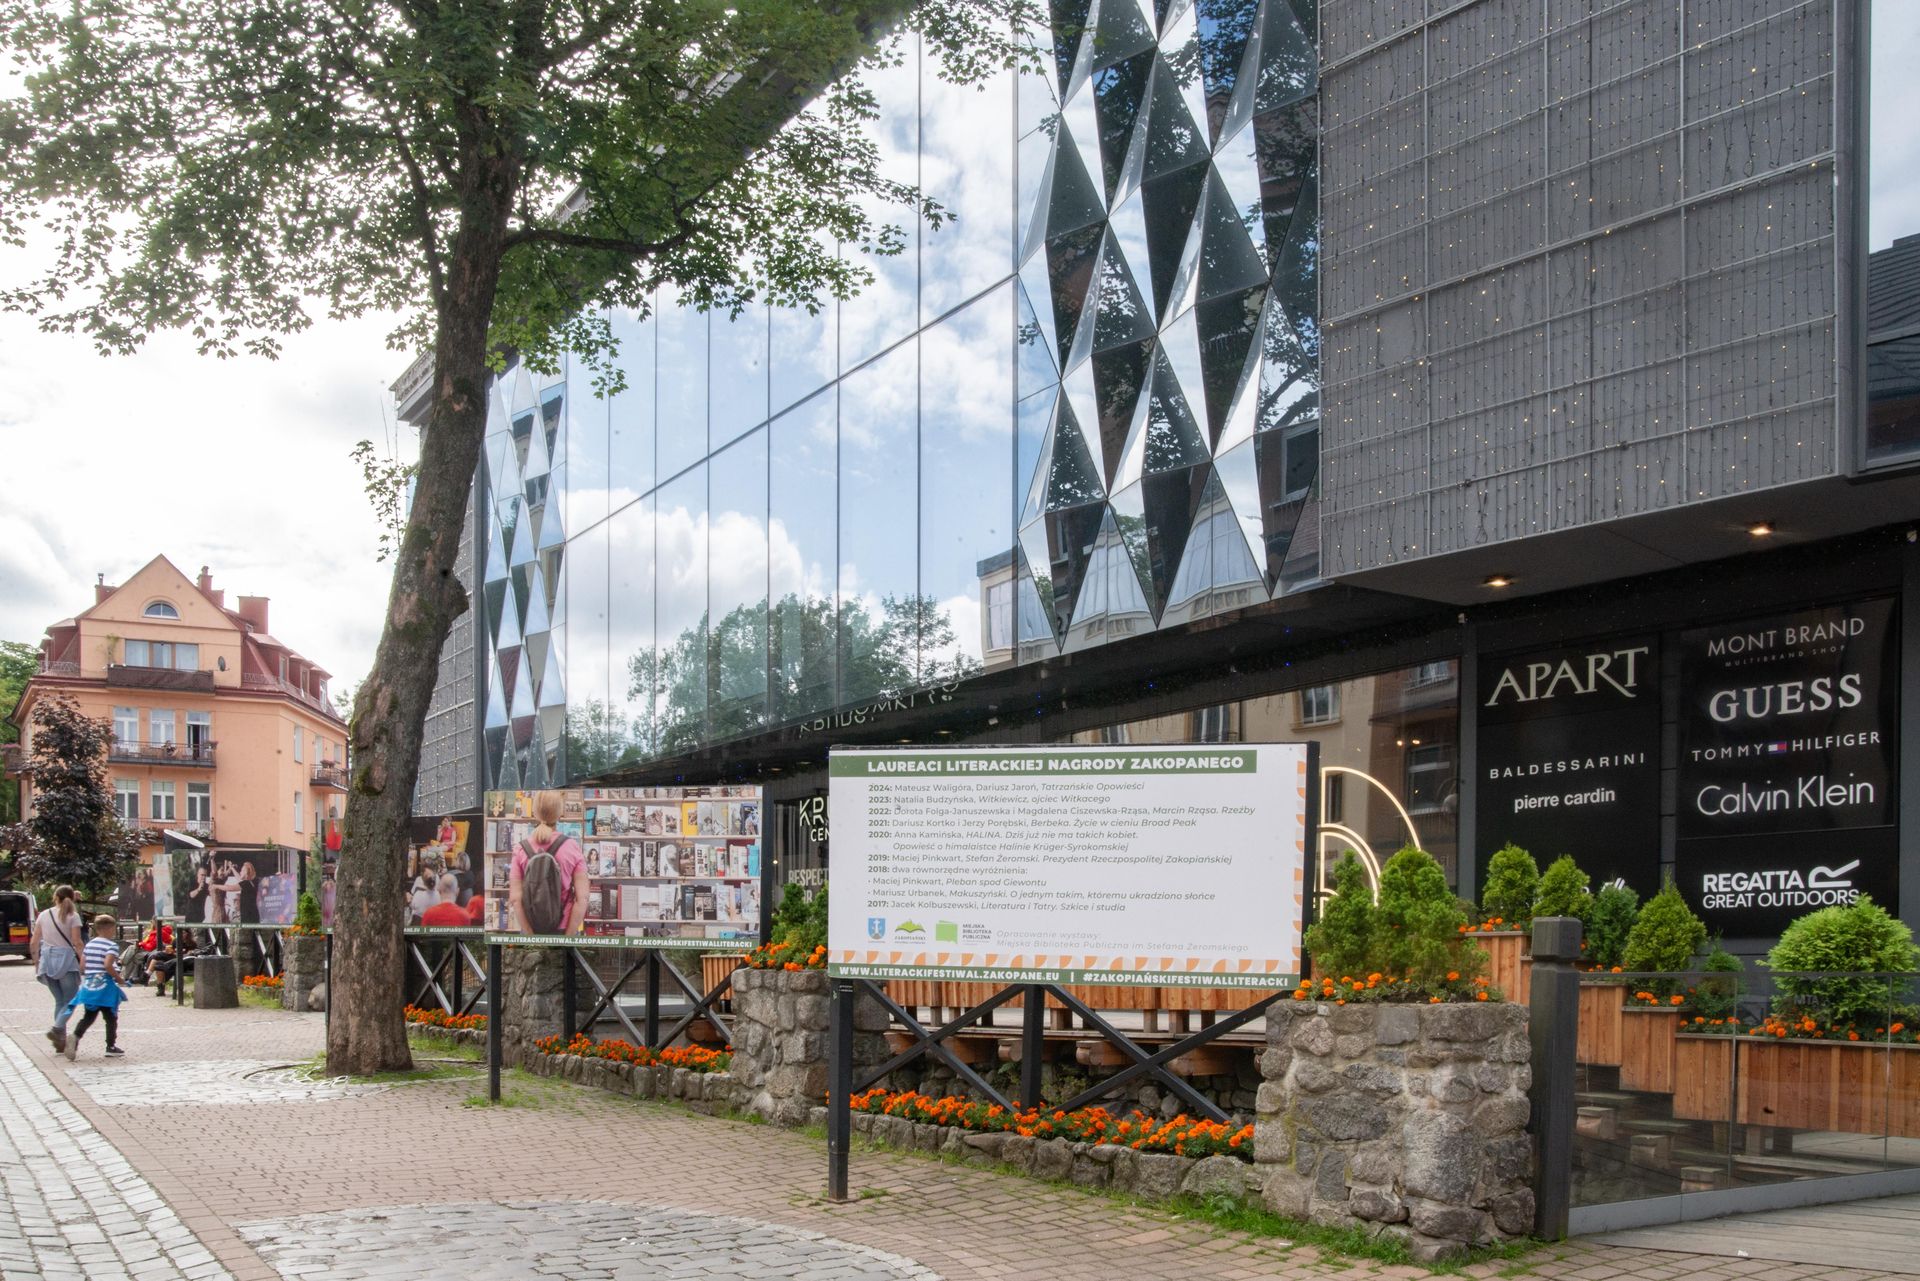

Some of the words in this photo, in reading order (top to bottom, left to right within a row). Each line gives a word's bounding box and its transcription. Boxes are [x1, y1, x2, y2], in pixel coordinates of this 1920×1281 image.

[1707, 631, 1777, 657] MONT
[1785, 618, 1865, 645] BRAND
[1724, 651, 1804, 667] MULTIBRAND
[1812, 645, 1846, 656] SHOP
[1484, 646, 1649, 707] APART
[1709, 673, 1862, 722] GUESS
[1692, 743, 1763, 762] TOMMY
[1792, 731, 1881, 751] HILFIGER
[868, 761, 941, 772] LAUREACI
[946, 760, 1043, 772] LITERACKIEJ
[1048, 758, 1126, 770] NAGRODY
[1130, 756, 1244, 769] ZAKOPANEGO
[1489, 752, 1645, 779] BALDESSARINI
[869, 783, 892, 792] 2024:
[895, 783, 930, 792] Mateusz
[933, 783, 973, 794] Waligóra,
[976, 783, 1009, 792] Dariusz
[1011, 783, 1038, 793] Jaroń,
[1041, 782, 1094, 791] Tatrzańskie
[1097, 782, 1144, 793] Opowieści
[1697, 780, 1790, 816] Calvin
[1798, 773, 1874, 809] Klein
[869, 795, 891, 804] 2023:
[894, 795, 923, 804] Natalia
[1032, 795, 1057, 805] ojciec
[1061, 794, 1110, 805] Witkacego
[1513, 794, 1560, 813] pierre
[1564, 787, 1616, 806] cardin
[799, 796, 830, 827] KR
[869, 807, 891, 815] 2022:
[926, 807, 1010, 817] Folga-Januszewska
[1018, 807, 1067, 817] Magdalena
[1153, 806, 1185, 815] Marcin
[869, 819, 890, 827] 2021:
[893, 819, 924, 827] Dariusz
[927, 819, 955, 827] Kortko
[962, 819, 985, 829] Jerzy
[1031, 819, 1071, 827] Berbeka.
[1074, 817, 1097, 829] Życie
[1111, 818, 1139, 827] cieniu
[1141, 818, 1170, 827] Broad
[1173, 818, 1196, 827] Peak
[869, 830, 892, 839] 2020:
[895, 830, 917, 839] Anna
[1005, 831, 1024, 839] Dziś
[1025, 831, 1040, 841] już
[1042, 831, 1057, 839] nie
[1076, 830, 1104, 839] takich
[1107, 830, 1139, 839] kobiet.
[946, 843, 997, 851] himalaistce
[999, 843, 1030, 851] Halinie
[868, 853, 890, 862] 2019:
[892, 853, 920, 864] Maciej
[923, 854, 963, 863] Pinkwart,
[966, 854, 994, 862] Stefan
[997, 853, 1040, 863] Żeromski.
[1043, 855, 1089, 865] Prezydent
[1091, 855, 1163, 866] Rzeczpospolitej
[1165, 855, 1232, 866] Zakopiańskiej
[868, 865, 890, 873] 2018:
[892, 865, 910, 874] dwa
[873, 877, 900, 887] Maciej
[903, 877, 944, 887] Pinkwart,
[946, 878, 977, 886] Pleban
[980, 878, 1001, 888] spod
[1003, 878, 1047, 887] Giewontu
[1703, 870, 1804, 893] REGATTA
[873, 888, 905, 897] Mariusz
[1019, 890, 1054, 901] jednym
[1056, 891, 1085, 900] takim,
[1088, 891, 1127, 900] któremu
[1129, 891, 1182, 900] ukradziono
[1702, 893, 1755, 909] GREAT
[1757, 889, 1859, 907] OUTDOORS
[868, 899, 889, 908] 2017:
[891, 900, 915, 908] Jacek
[918, 900, 979, 910] Kolbuszewski,
[981, 901, 1025, 910] Literatura
[1033, 902, 1057, 912] Tatry.
[1060, 902, 1089, 911] Szkice
[1096, 903, 1126, 911] studia
[839, 966, 1060, 981] WWW.LITERACKIFESTIWAL.ZAKOPANE.EU
[1083, 972, 1288, 986] #ZAKOPIAŃSKIFESTIWALLITERACKI
